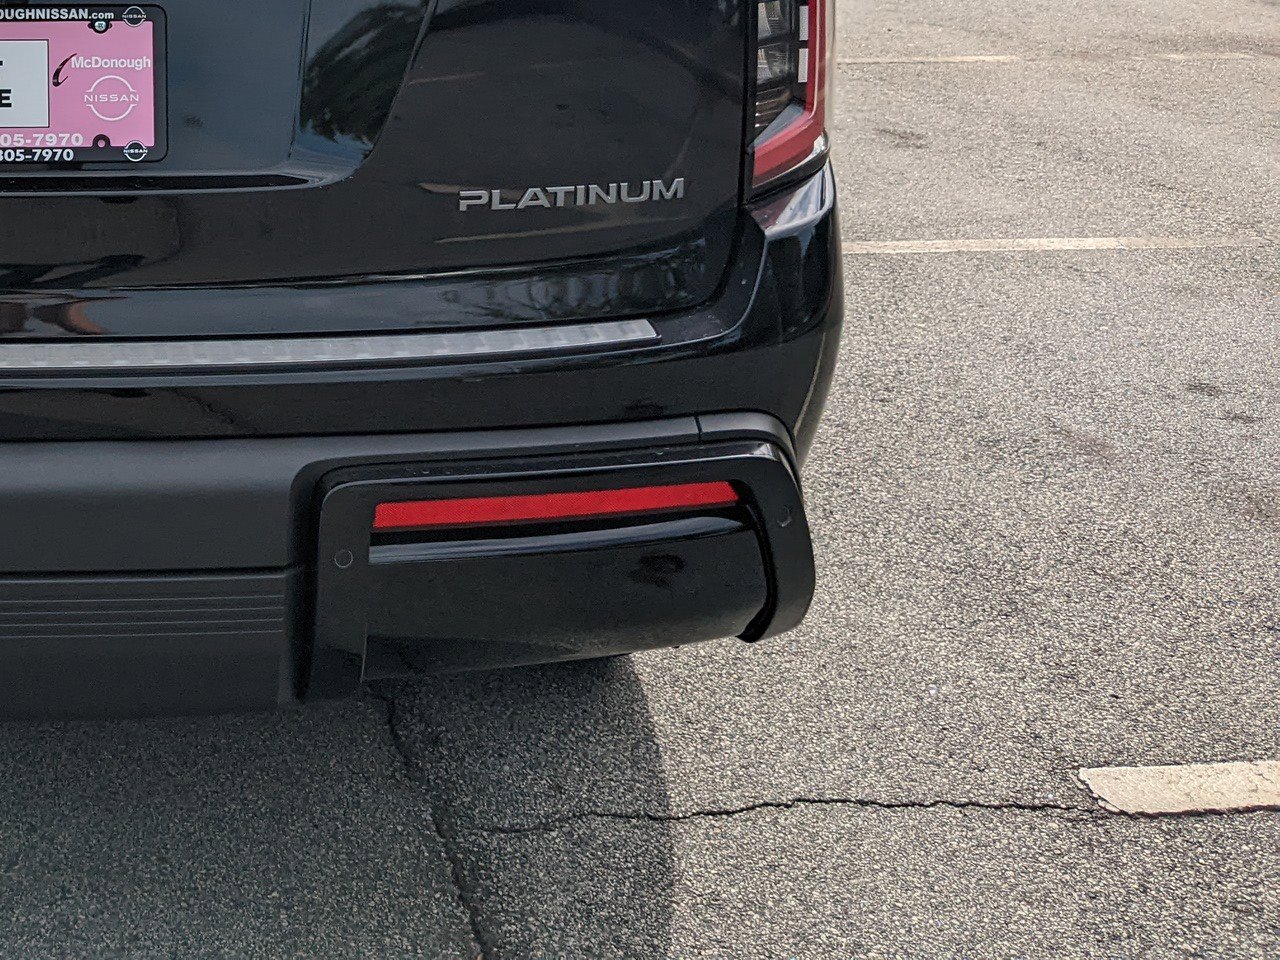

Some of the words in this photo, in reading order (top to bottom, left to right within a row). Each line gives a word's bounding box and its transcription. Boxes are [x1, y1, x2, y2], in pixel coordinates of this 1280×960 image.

[71, 56, 151, 71] McDonough
[84, 94, 139, 102] NISSAN
[459, 177, 684, 211] PLATINUM
